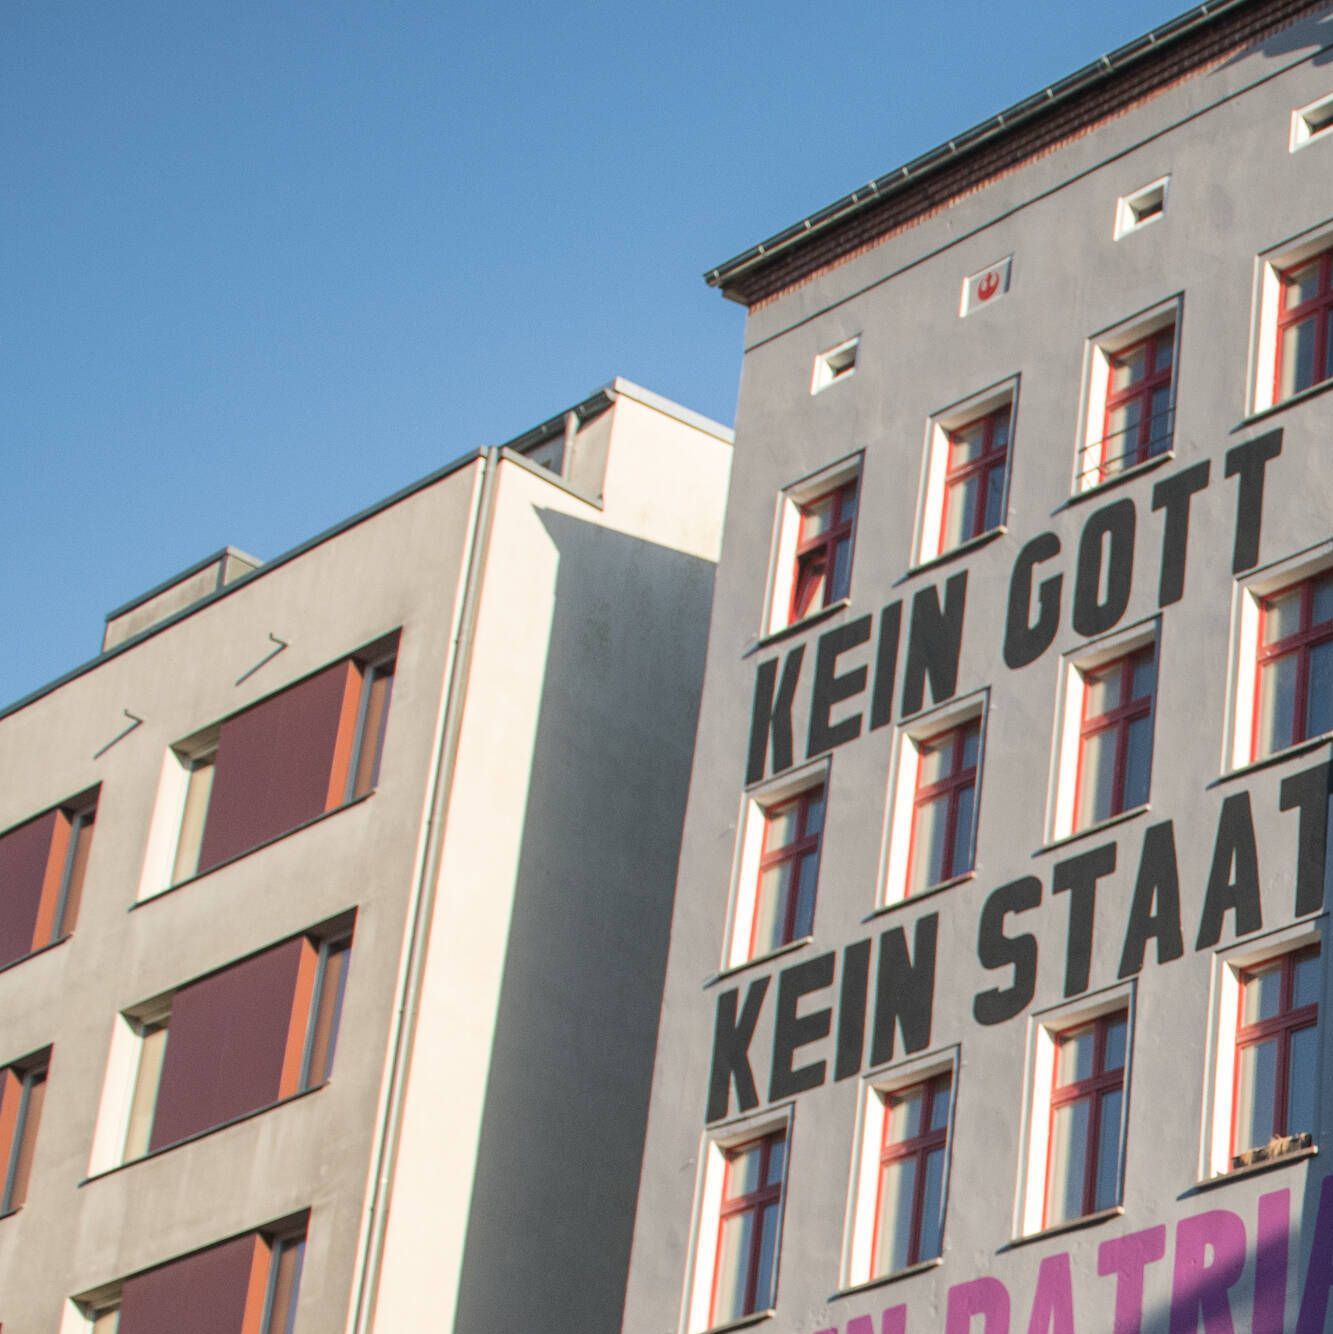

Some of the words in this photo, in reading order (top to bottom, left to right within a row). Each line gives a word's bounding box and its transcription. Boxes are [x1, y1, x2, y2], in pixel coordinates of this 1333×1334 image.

[745, 569, 968, 786] KEIN
[1003, 427, 1284, 670] GOTT
[705, 912, 939, 1124] KEIN
